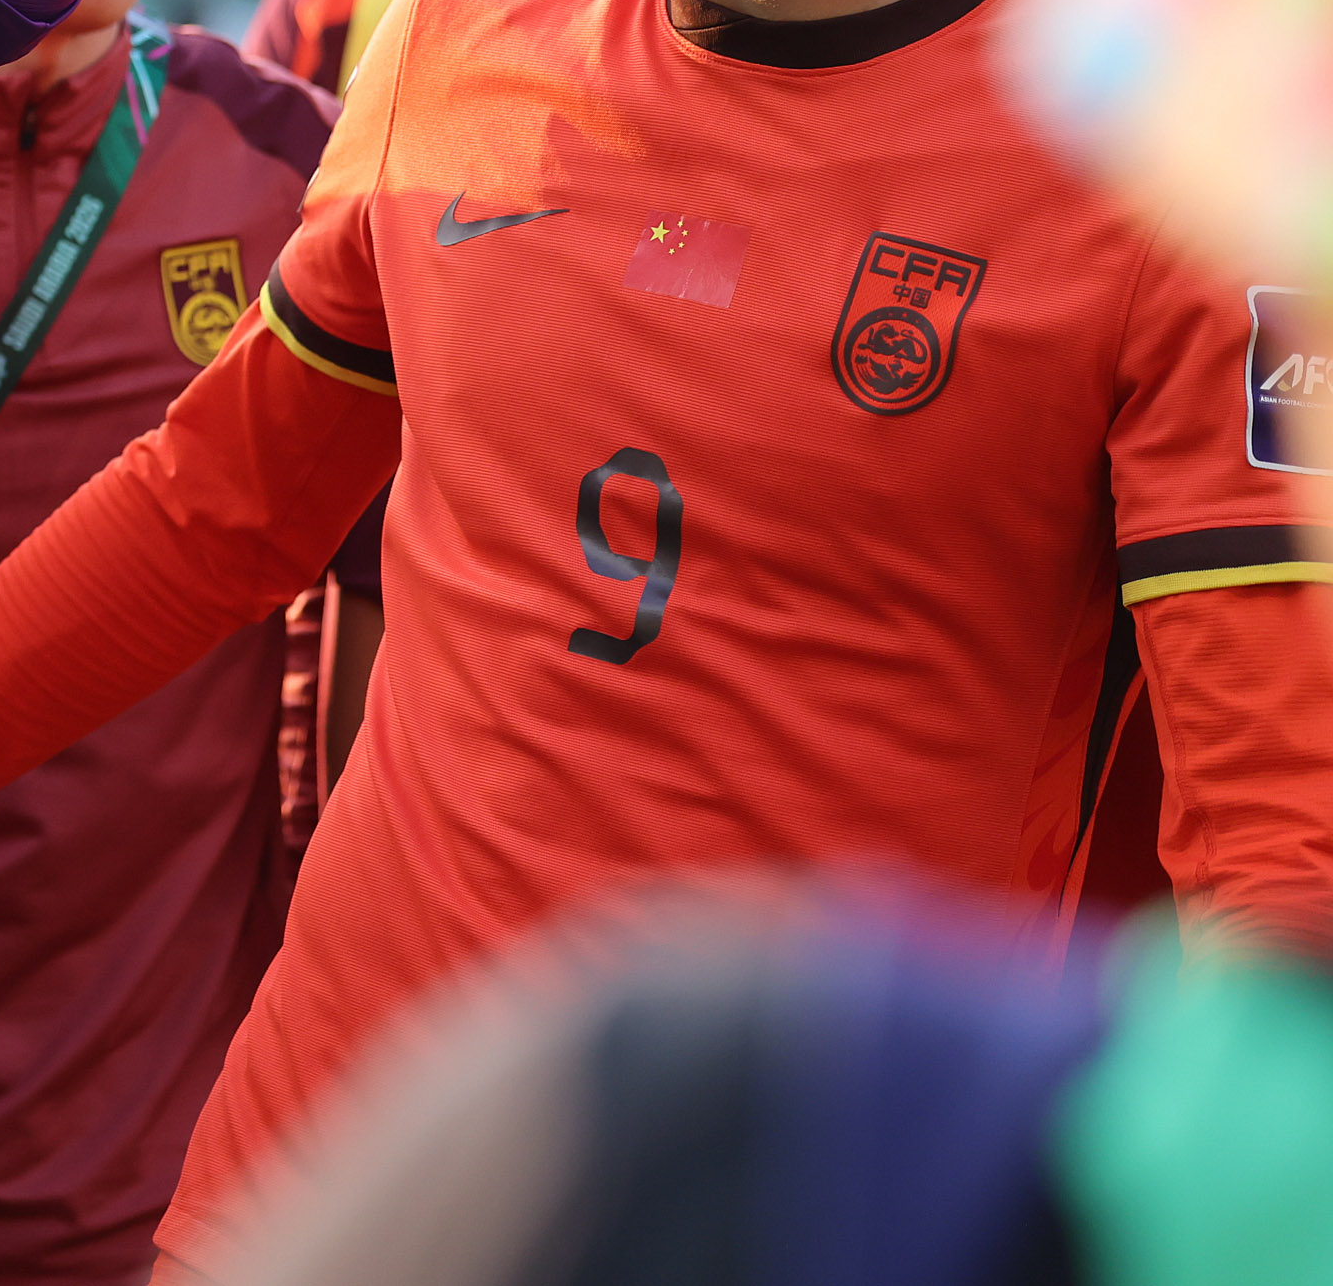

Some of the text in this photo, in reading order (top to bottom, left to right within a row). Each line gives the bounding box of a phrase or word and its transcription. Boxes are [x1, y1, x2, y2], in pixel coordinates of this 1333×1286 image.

[869, 244, 972, 297] CFA
[892, 282, 933, 309] 中国
[566, 446, 684, 666] 9
